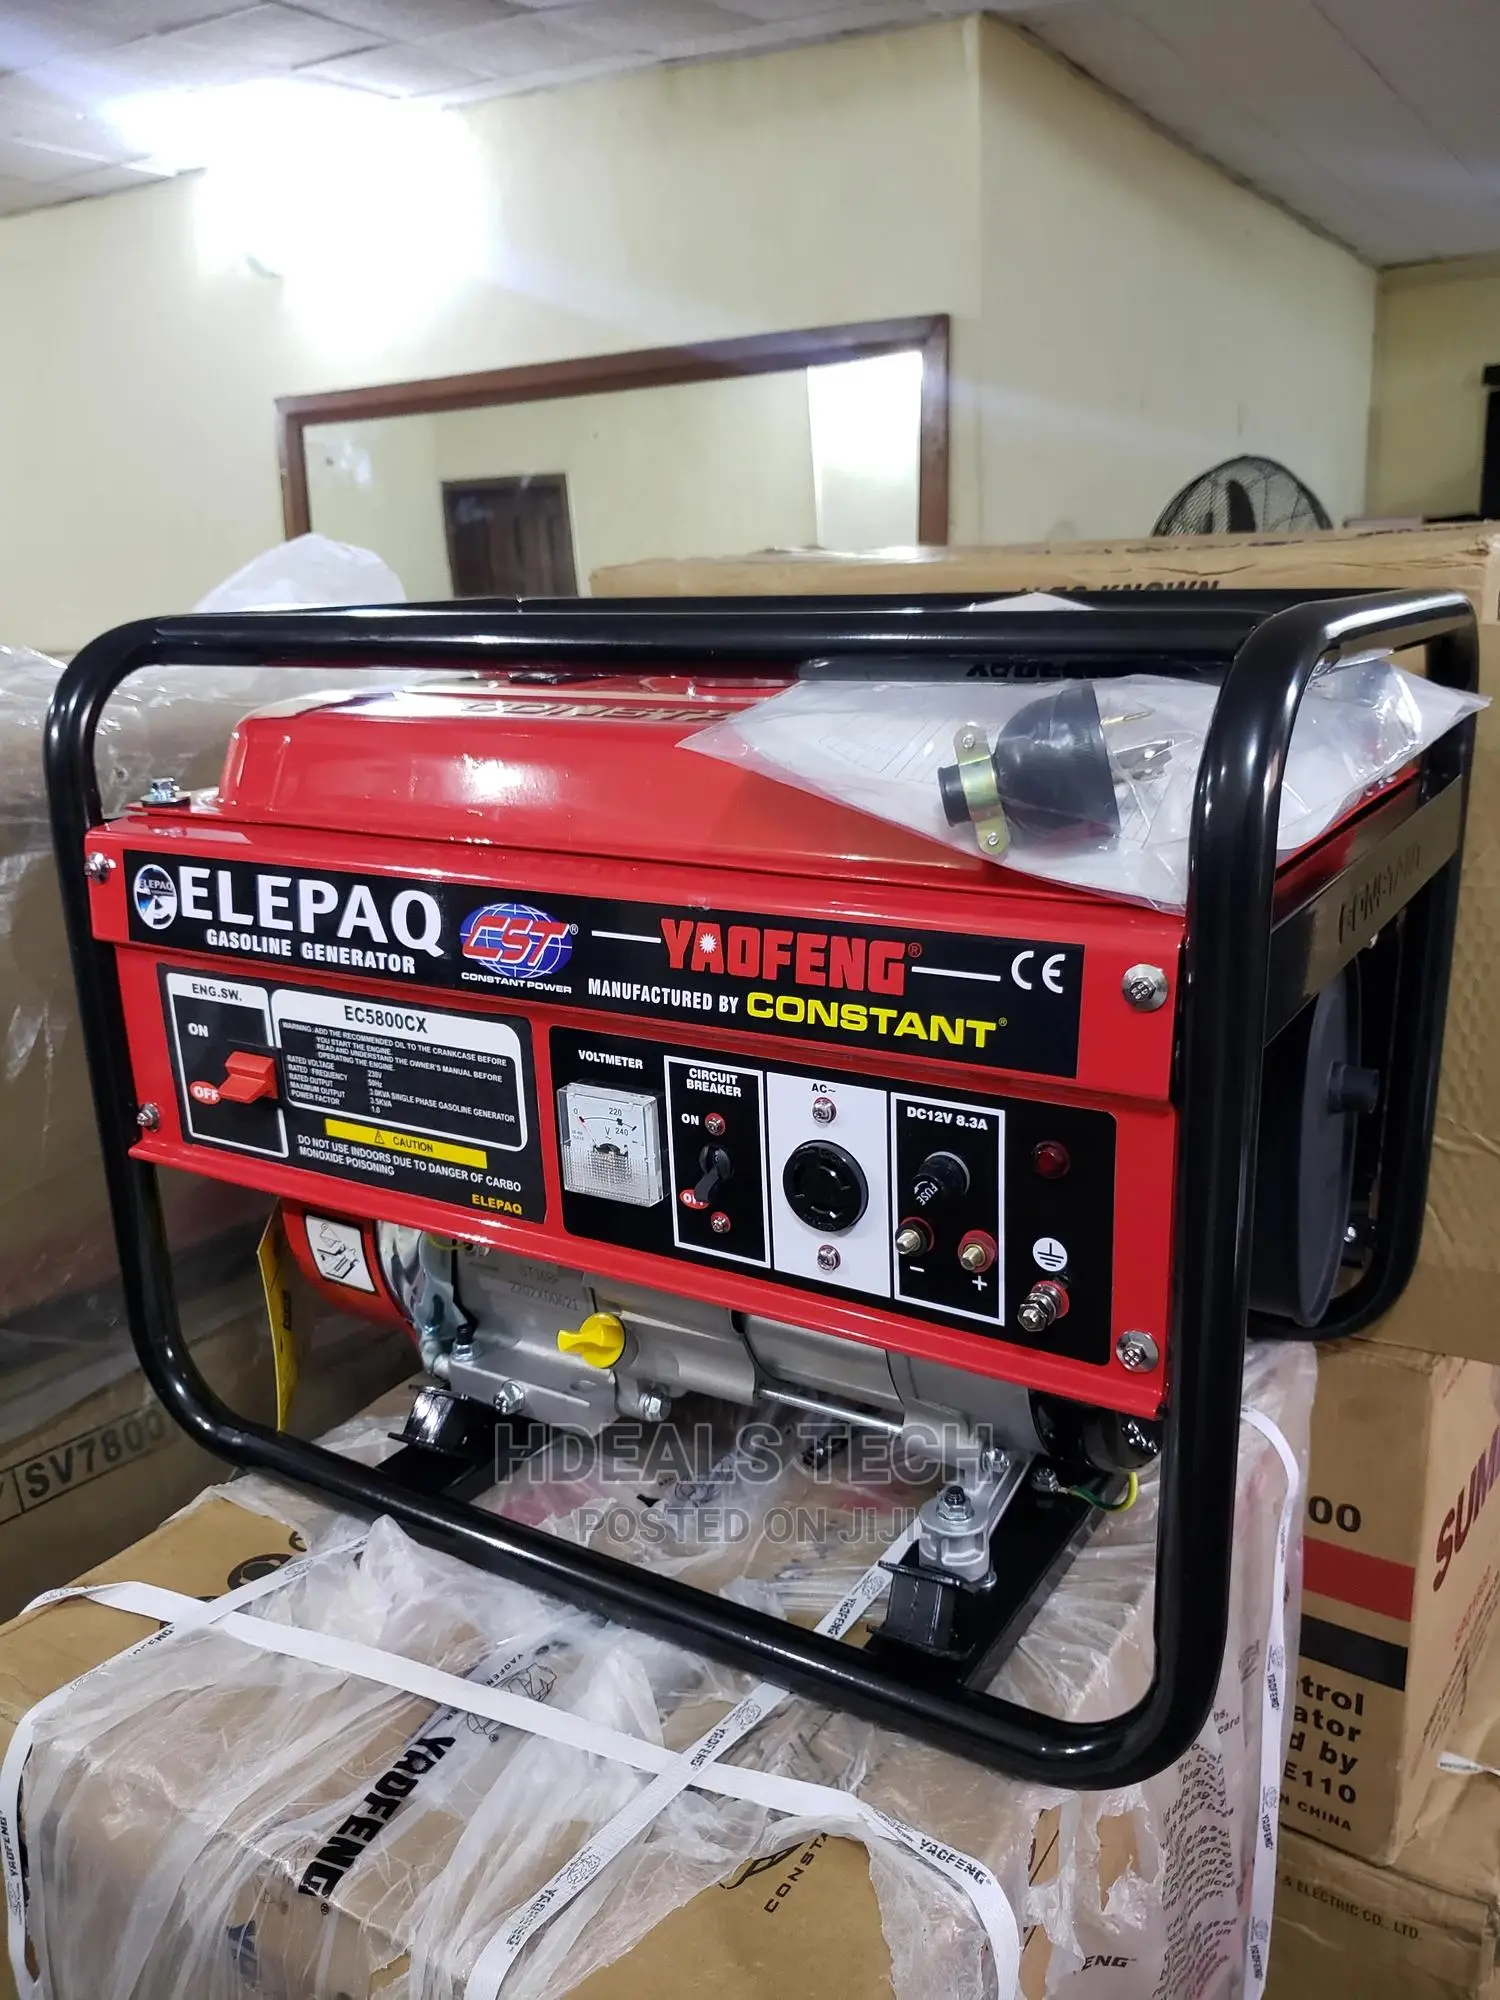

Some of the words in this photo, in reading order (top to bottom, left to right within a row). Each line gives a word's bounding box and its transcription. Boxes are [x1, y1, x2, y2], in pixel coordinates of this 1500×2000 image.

[178, 865, 445, 958] ELEPAQ
[206, 928, 292, 957] GASOLINE
[301, 942, 416, 975] GENERATOR
[462, 914, 571, 967] CST
[660, 918, 906, 996] YAOFENG
[461, 972, 527, 988] CONSTANT
[527, 981, 572, 994] POWER
[1011, 950, 1066, 994] CE
[191, 983, 243, 1001] ENG.SW.
[344, 1005, 428, 1034] EC5800CX
[588, 978, 713, 1012] MANUFACTURED
[718, 995, 739, 1014] BY
[747, 992, 997, 1048] CONSTANT
[188, 1022, 209, 1037] ON
[314, 1027, 329, 1036] ADD
[329, 1029, 342, 1038] THE
[342, 1031, 394, 1047] RECOMMENDED
[394, 1041, 406, 1049] OIL
[407, 1043, 417, 1051] TO
[418, 1044, 431, 1053] THE
[432, 1047, 476, 1062] CRANKCASE
[477, 1055, 508, 1067] BEFORE
[316, 1037, 330, 1045] YOU
[331, 1039, 351, 1048] START
[352, 1042, 366, 1051] THE
[287, 1054, 307, 1065] RATED
[307, 1059, 335, 1070] VOLTAGE
[316, 1044, 335, 1053] READ
[335, 1046, 350, 1055] AND
[350, 1049, 394, 1063] UNDERSTAND
[395, 1057, 409, 1066] THE
[409, 1060, 442, 1072] OWNER'S
[442, 1065, 472, 1077] MANUAL
[473, 1071, 503, 1083] BEFORE
[318, 1052, 354, 1064] OPERATING
[355, 1058, 368, 1067] THE
[578, 1050, 644, 1070] VOLTMETER
[288, 1064, 308, 1074] RATED
[311, 1068, 348, 1081] FREQUENCY
[688, 1067, 738, 1085] CIRCUIT
[193, 1086, 220, 1101] OFF
[289, 1073, 309, 1082] RATED
[309, 1076, 333, 1087] OUTPUT
[391, 1092, 415, 1104] SINGLE
[415, 1097, 438, 1108] PHASE
[438, 1101, 472, 1115] GASOLINE
[473, 1108, 515, 1123] GENERATOR
[290, 1081, 320, 1093] MAXIMUM
[321, 1087, 345, 1098] OUTPUT
[291, 1090, 314, 1100] POWER
[315, 1095, 340, 1105] FACTOR
[686, 1079, 742, 1098] BREAKER
[608, 1107, 622, 1117] 220
[681, 1113, 700, 1126] ON
[906, 1106, 953, 1125] DC12V
[956, 1112, 988, 1131] 8.3A
[605, 1126, 611, 1135] V
[615, 1127, 629, 1137] 240
[393, 1136, 433, 1153] CAUTION
[298, 1134, 311, 1145] DO
[312, 1137, 330, 1149] NOT
[331, 1141, 349, 1153] USE
[351, 1145, 391, 1163] INDOORS
[393, 1155, 412, 1167] DUE
[414, 1159, 427, 1171] TO
[429, 1163, 469, 1181] DANGER
[470, 1172, 484, 1183] OF
[485, 1175, 521, 1192] CARBO
[299, 1146, 345, 1165] MONOXIDE
[346, 1156, 395, 1176] POISONING
[472, 1193, 523, 1215] ELEPAQ
[916, 1182, 938, 1206] FUSE
[24, 1408, 168, 1499] SV7800
[486, 1653, 524, 1687] YAOFEN
[1302, 1675, 1364, 1716] trol
[1319, 1740, 1358, 1775] by
[298, 1736, 456, 1899] YAOFENG
[1297, 1801, 1352, 1832] CHINA
[1296, 1880, 1360, 1917] ELECTRIC
